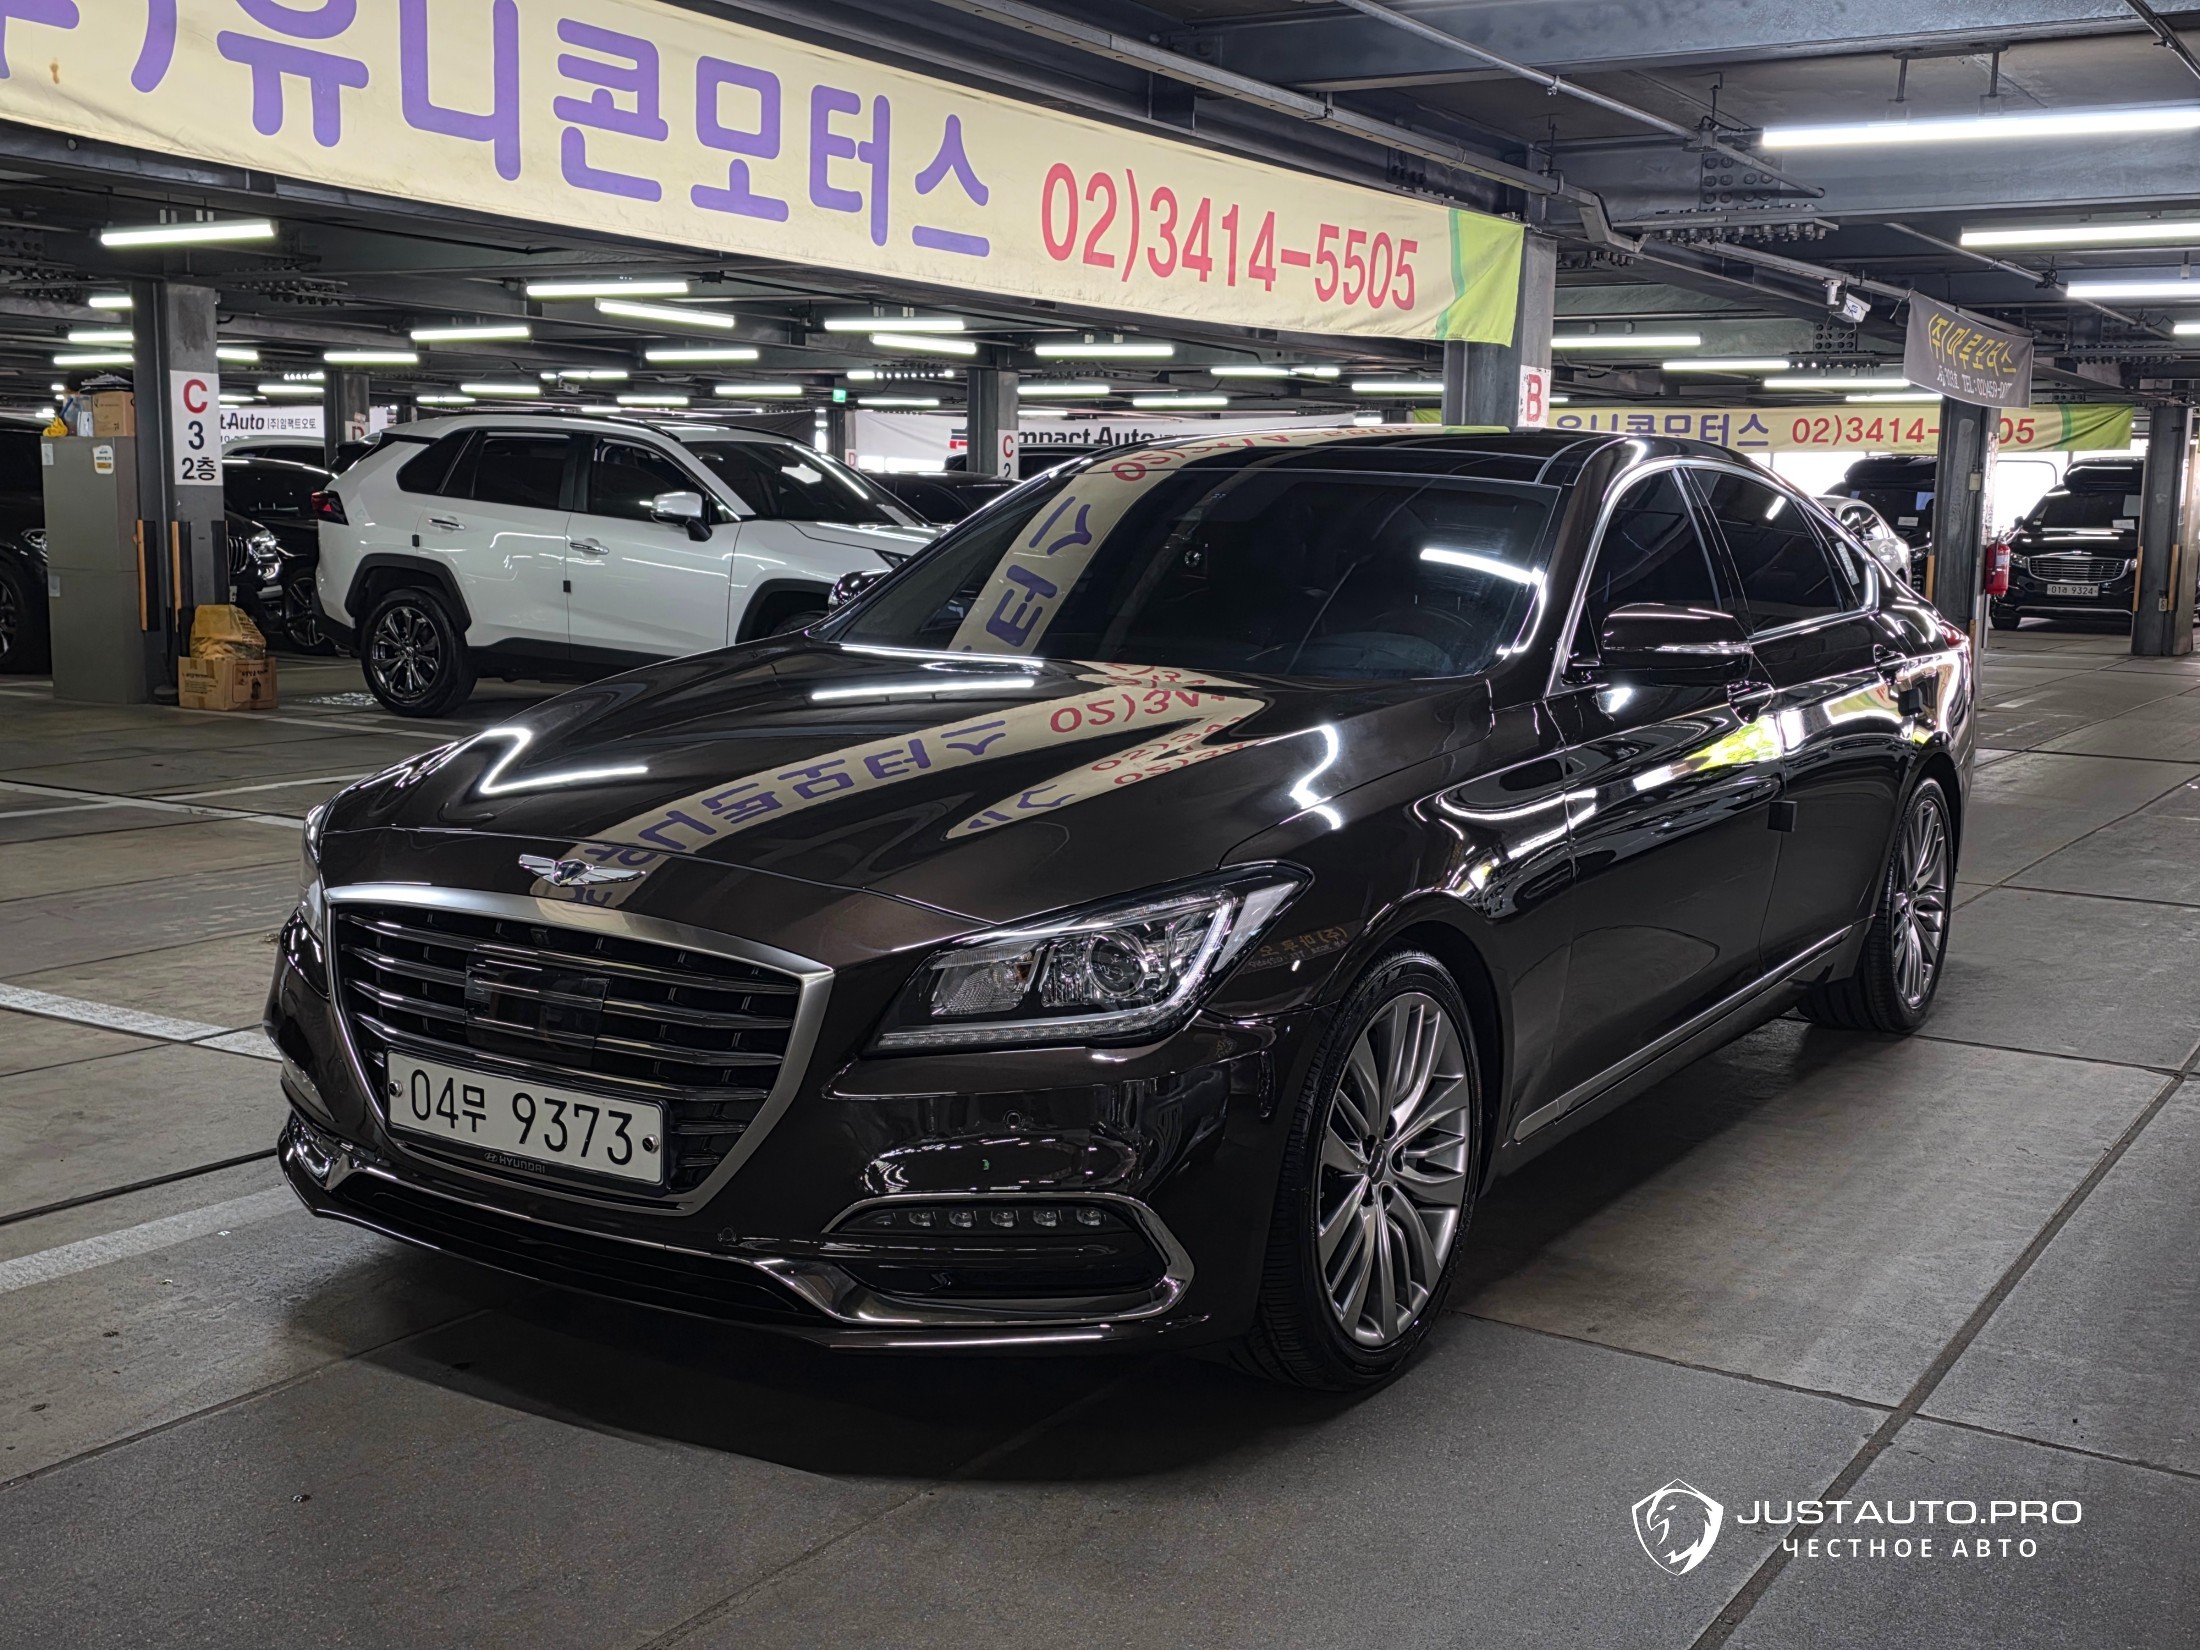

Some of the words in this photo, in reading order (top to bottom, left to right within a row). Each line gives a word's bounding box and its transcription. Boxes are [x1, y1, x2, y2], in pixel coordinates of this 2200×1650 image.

[1041, 162, 1419, 311] 02)3414-5505
[183, 378, 208, 414] C
[1526, 373, 1543, 422] B
[187, 420, 205, 450] 3
[1018, 427, 1091, 445] mpact
[1792, 414, 2035, 447] 02)3414-05
[1002, 434, 1014, 458] C
[181, 457, 216, 481] 2층
[2072, 586, 2093, 595] 9324
[411, 1069, 487, 1133] 04무
[512, 1092, 633, 1166] 9373
[499, 1155, 546, 1174] HYUNDAI
